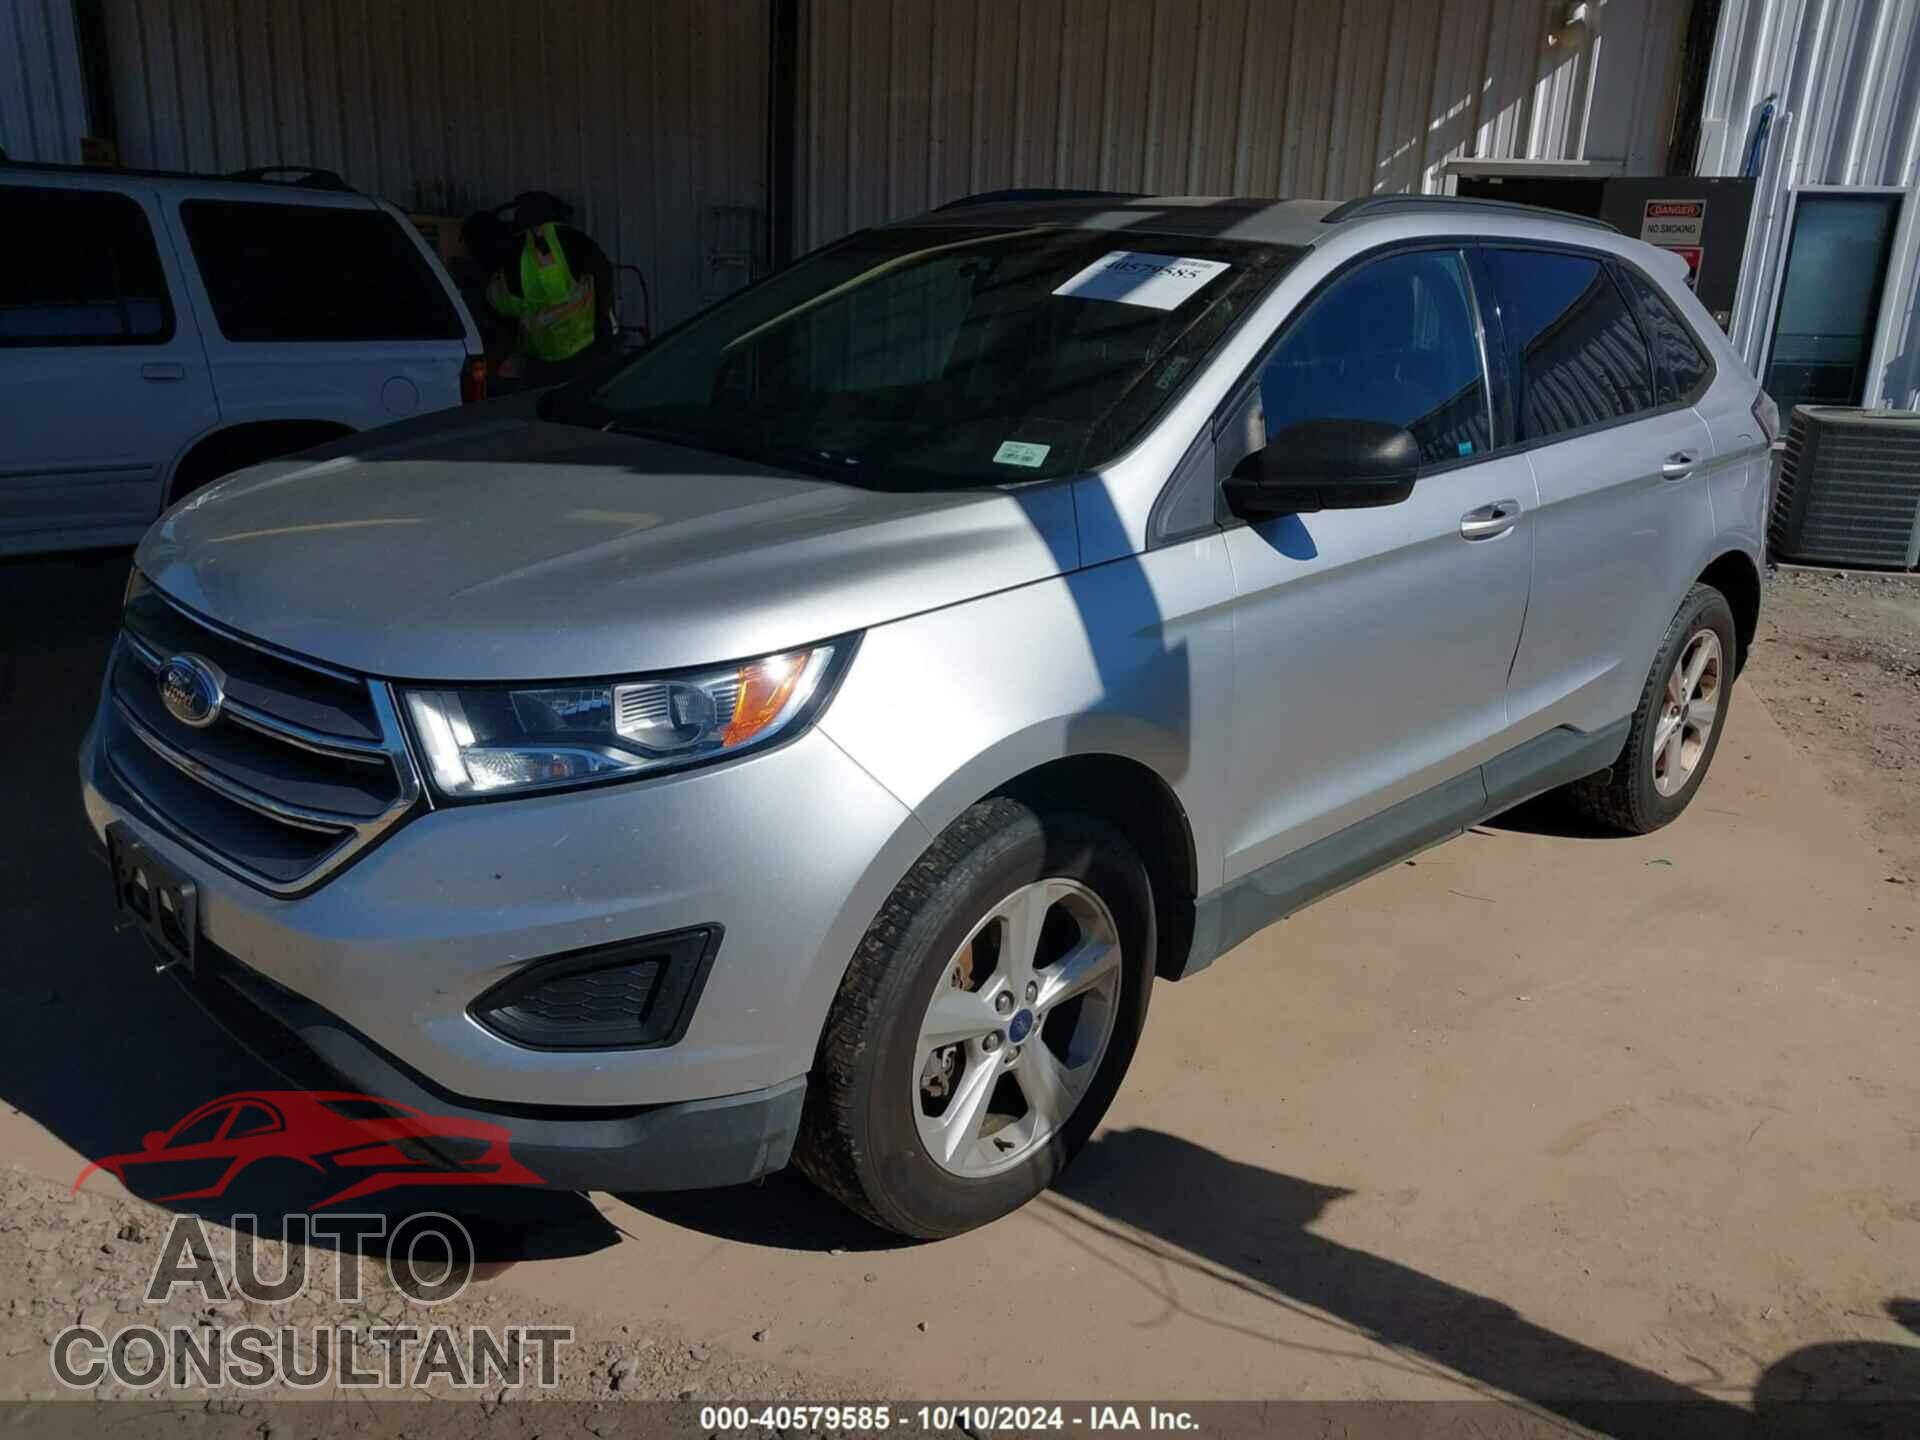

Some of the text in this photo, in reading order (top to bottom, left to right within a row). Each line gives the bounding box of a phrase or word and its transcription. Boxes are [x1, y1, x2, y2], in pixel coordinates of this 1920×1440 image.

[1654, 205, 1697, 216] DANGER
[1647, 224, 1697, 234] NO SMOKING
